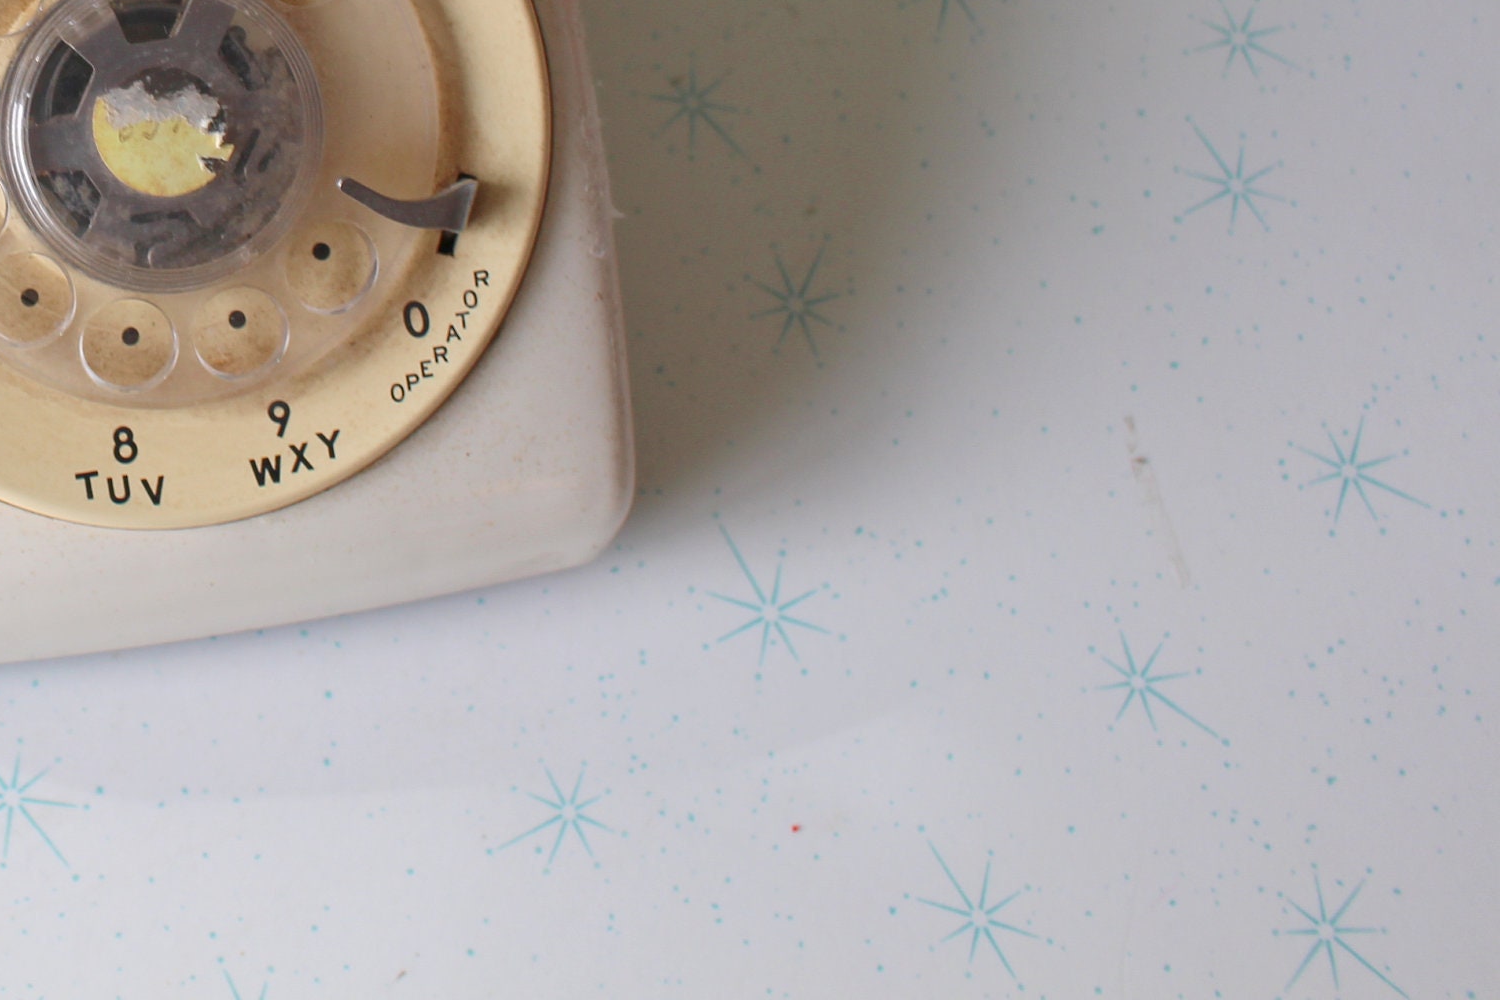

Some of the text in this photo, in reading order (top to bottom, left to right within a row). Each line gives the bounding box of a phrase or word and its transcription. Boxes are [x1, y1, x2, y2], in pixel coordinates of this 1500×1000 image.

[389, 269, 490, 404] OPERATOR
[267, 400, 292, 438] 9
[112, 426, 139, 465] 8
[249, 428, 341, 488] WXY
[75, 470, 165, 507] TUV
